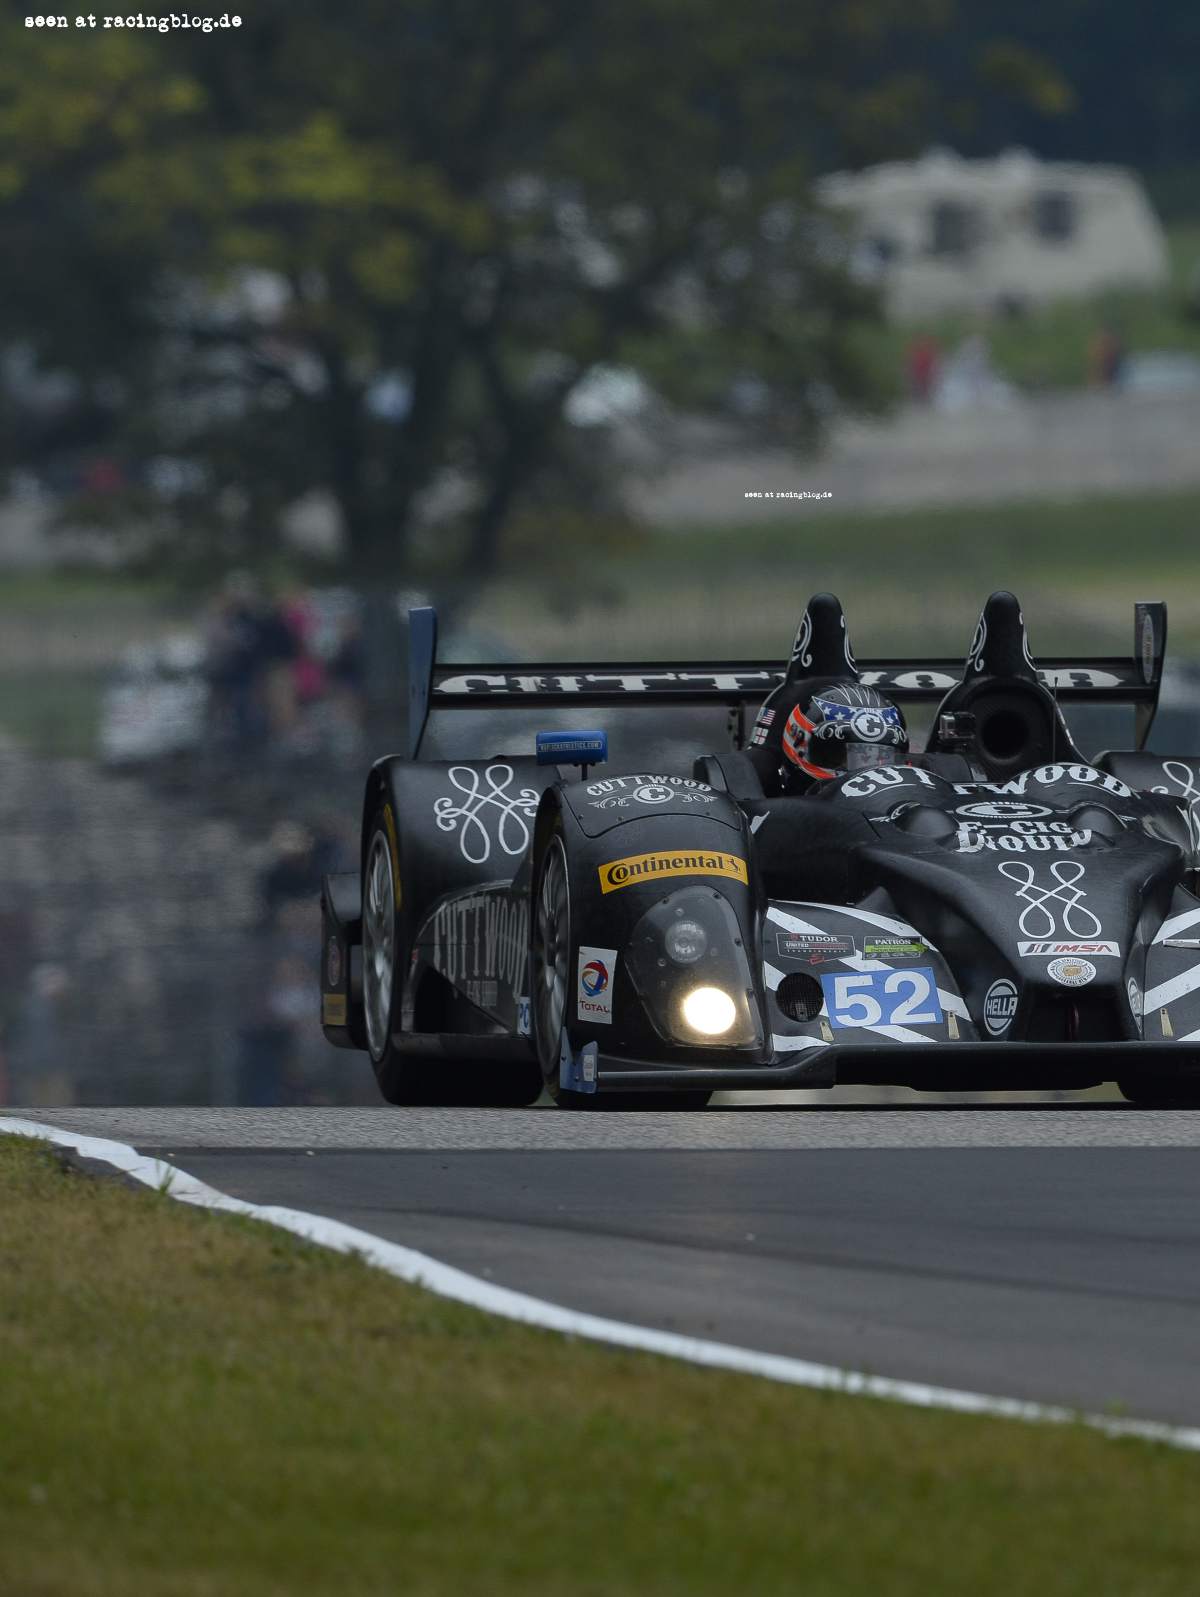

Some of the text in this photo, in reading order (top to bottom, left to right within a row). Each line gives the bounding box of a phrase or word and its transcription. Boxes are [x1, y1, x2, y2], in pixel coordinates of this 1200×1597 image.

[586, 775, 712, 796] CUTTWOOD
[607, 855, 724, 886] Continental
[800, 935, 838, 943] TUDOR
[1053, 944, 1113, 953] IMSA
[579, 1000, 610, 1014] TOTAL
[834, 970, 937, 1027] 52
[987, 996, 1019, 1016] HELLA
